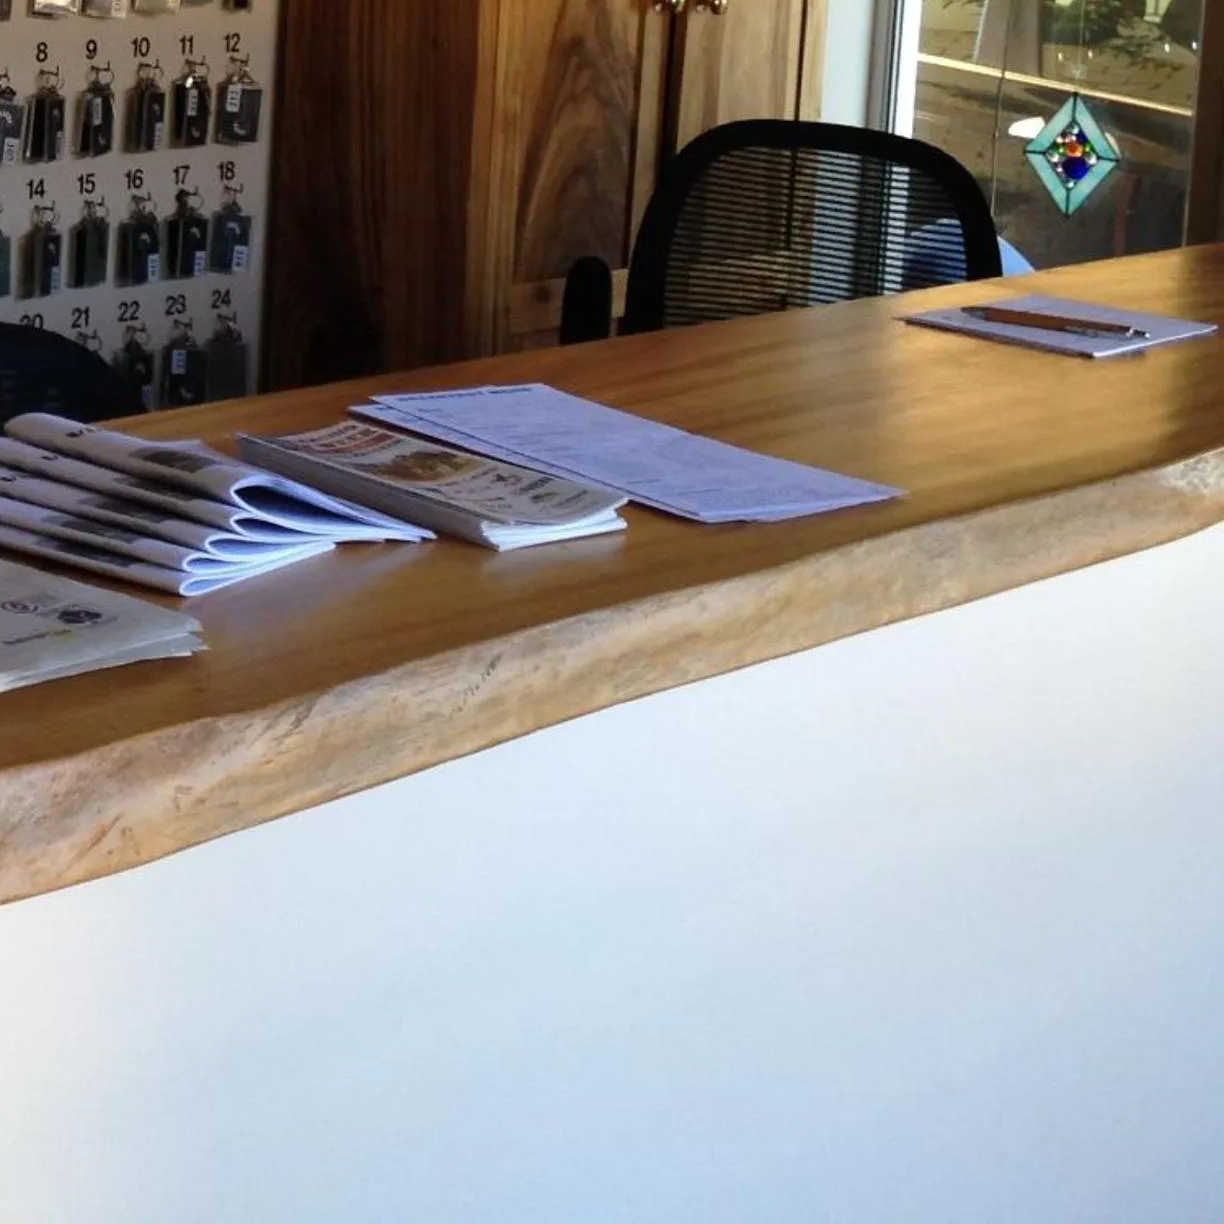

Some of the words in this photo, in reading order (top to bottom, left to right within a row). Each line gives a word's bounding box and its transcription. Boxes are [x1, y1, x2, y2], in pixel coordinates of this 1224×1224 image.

[35, 41, 48, 63] 8
[85, 39, 98, 60] 9
[131, 36, 151, 58] 10
[179, 35, 194, 56] 11
[224, 32, 241, 53] 12
[125, 168, 144, 190] 16
[172, 164, 191, 186] 17
[218, 160, 235, 181] 18
[26, 178, 46, 200] 14
[77, 172, 96, 195] 15
[165, 294, 186, 316] 23
[211, 288, 232, 310] 24
[70, 305, 90, 329] 21
[117, 300, 140, 323] 22
